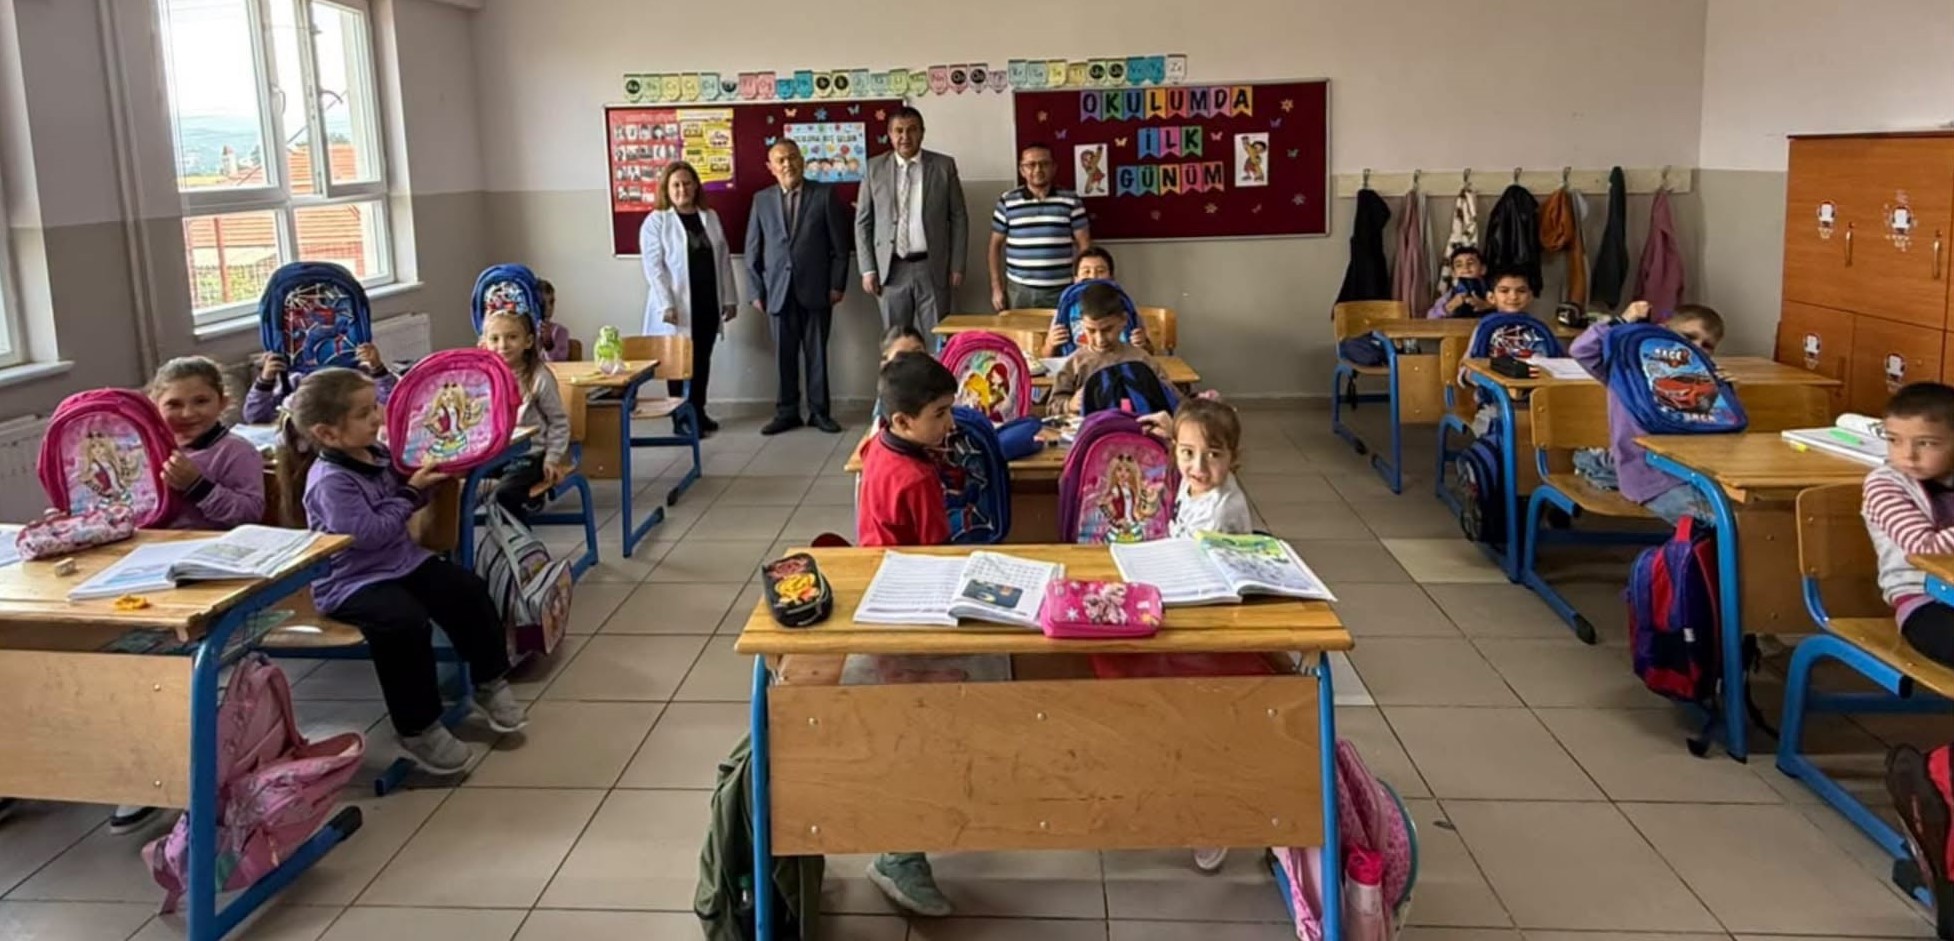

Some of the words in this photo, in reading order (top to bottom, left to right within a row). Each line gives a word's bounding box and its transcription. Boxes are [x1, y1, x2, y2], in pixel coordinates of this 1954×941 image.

[1083, 89, 1249, 113] OKULUMDA
[1146, 127, 1199, 150] İLK
[1120, 164, 1222, 188] GÜNÜM
